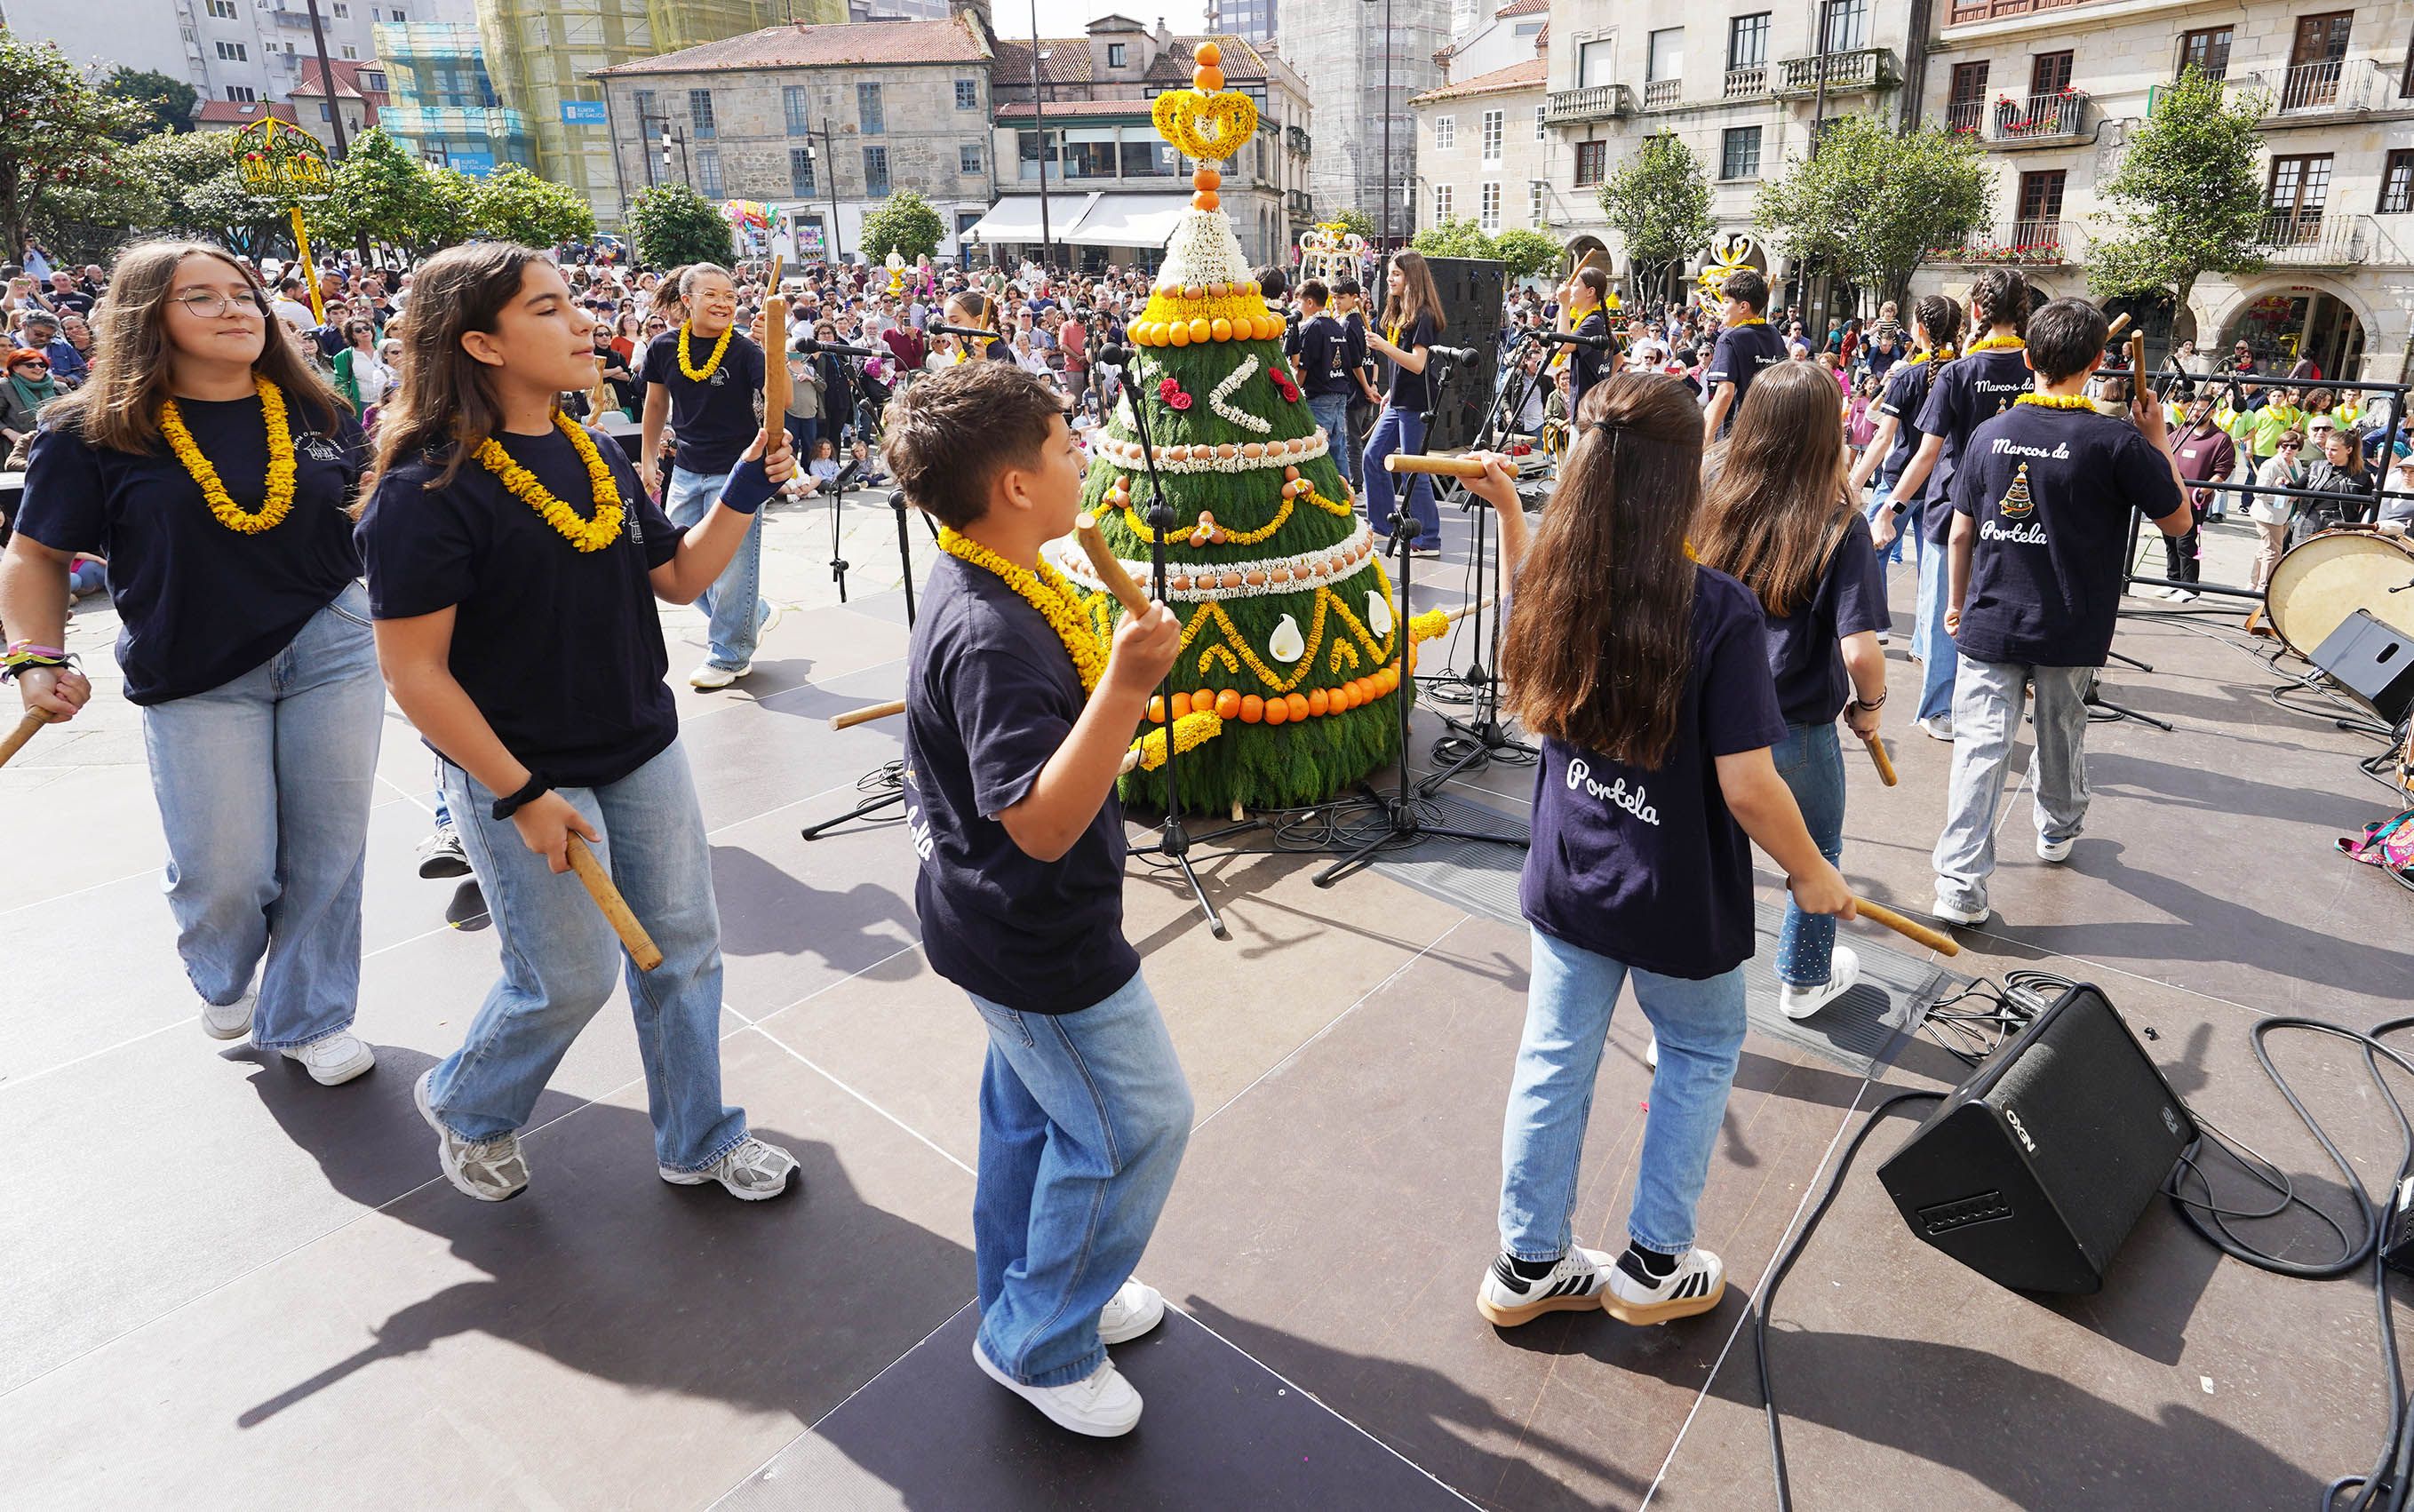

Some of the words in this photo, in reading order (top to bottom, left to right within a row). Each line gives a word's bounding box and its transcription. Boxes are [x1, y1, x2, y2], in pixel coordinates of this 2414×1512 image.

[1974, 379, 2020, 393] Marcos
[2020, 377, 2035, 391] da
[1991, 438, 2051, 458] Marcos
[2052, 442, 2070, 459] da
[1980, 520, 2048, 545] Portela
[1566, 758, 1660, 826] Portela
[2006, 1110, 2036, 1152] NEXO
